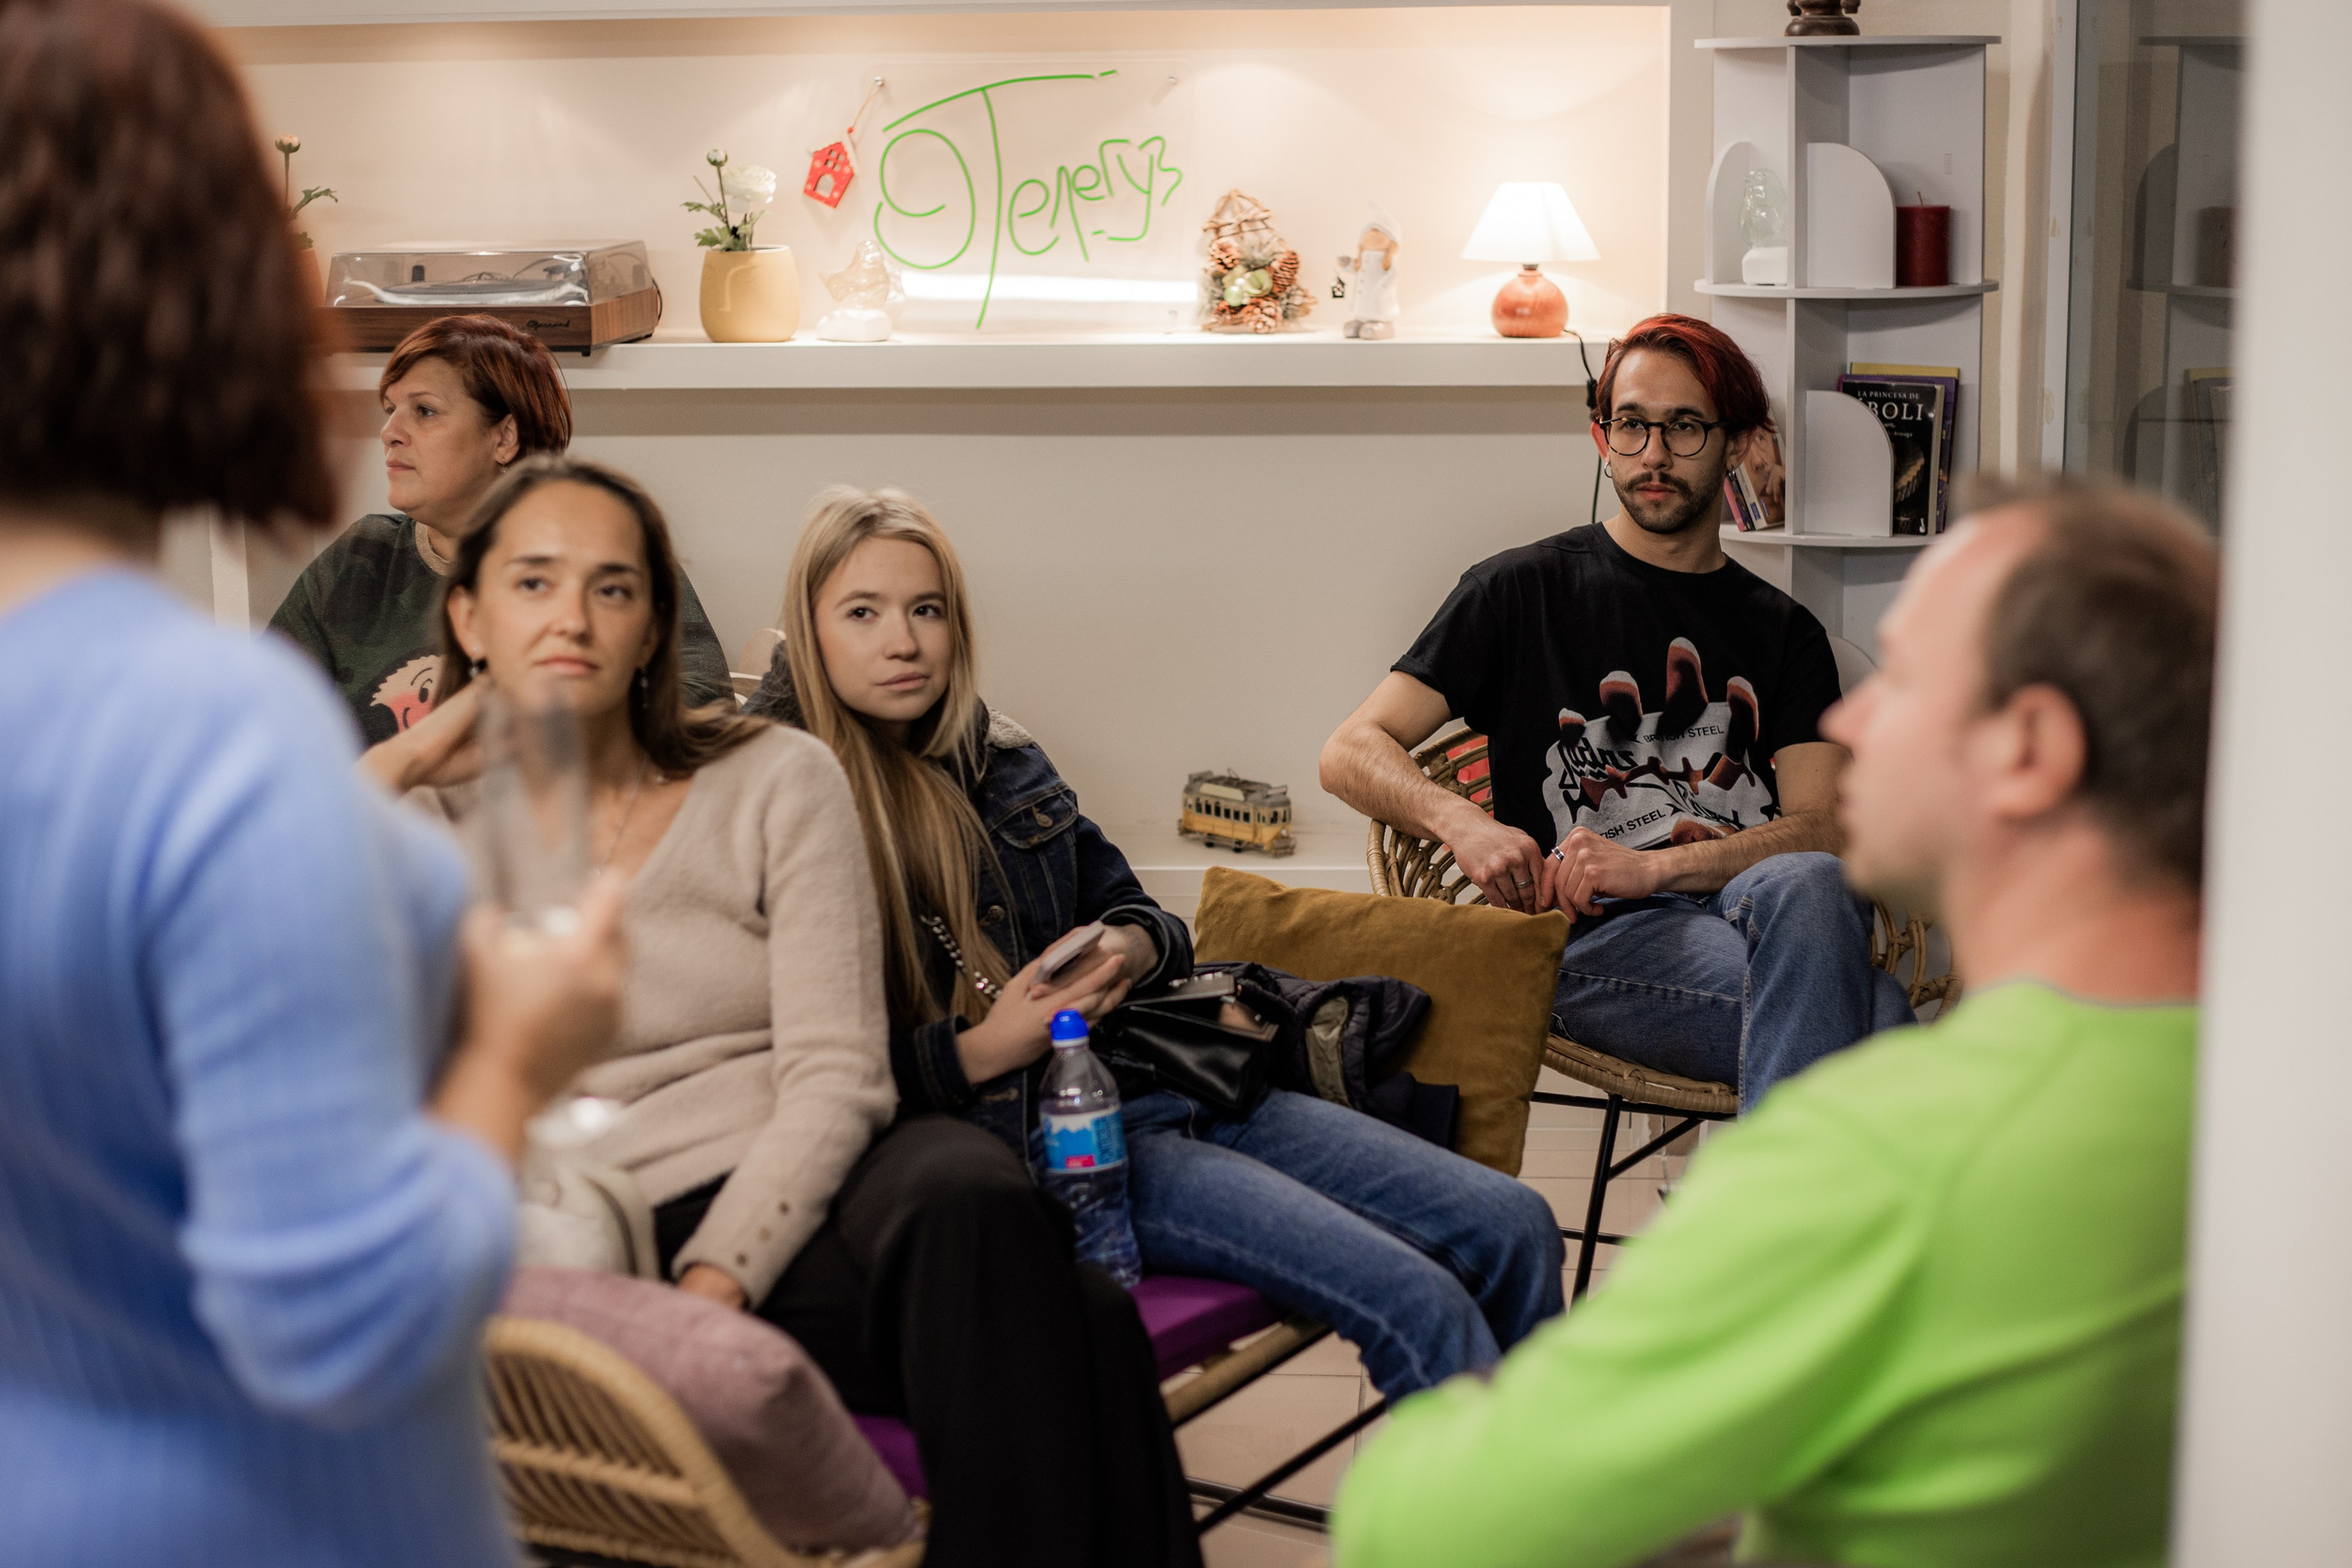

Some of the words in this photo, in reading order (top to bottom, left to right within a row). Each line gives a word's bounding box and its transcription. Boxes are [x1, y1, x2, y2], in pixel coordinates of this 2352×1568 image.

[1857, 389, 1868, 398] LA
[1869, 390, 1907, 400] PRINCESA
[1909, 392, 1920, 400] DE
[1859, 397, 1924, 421] BOLI
[1687, 725, 1725, 739] STEEL
[1626, 809, 1667, 831] STEEL
